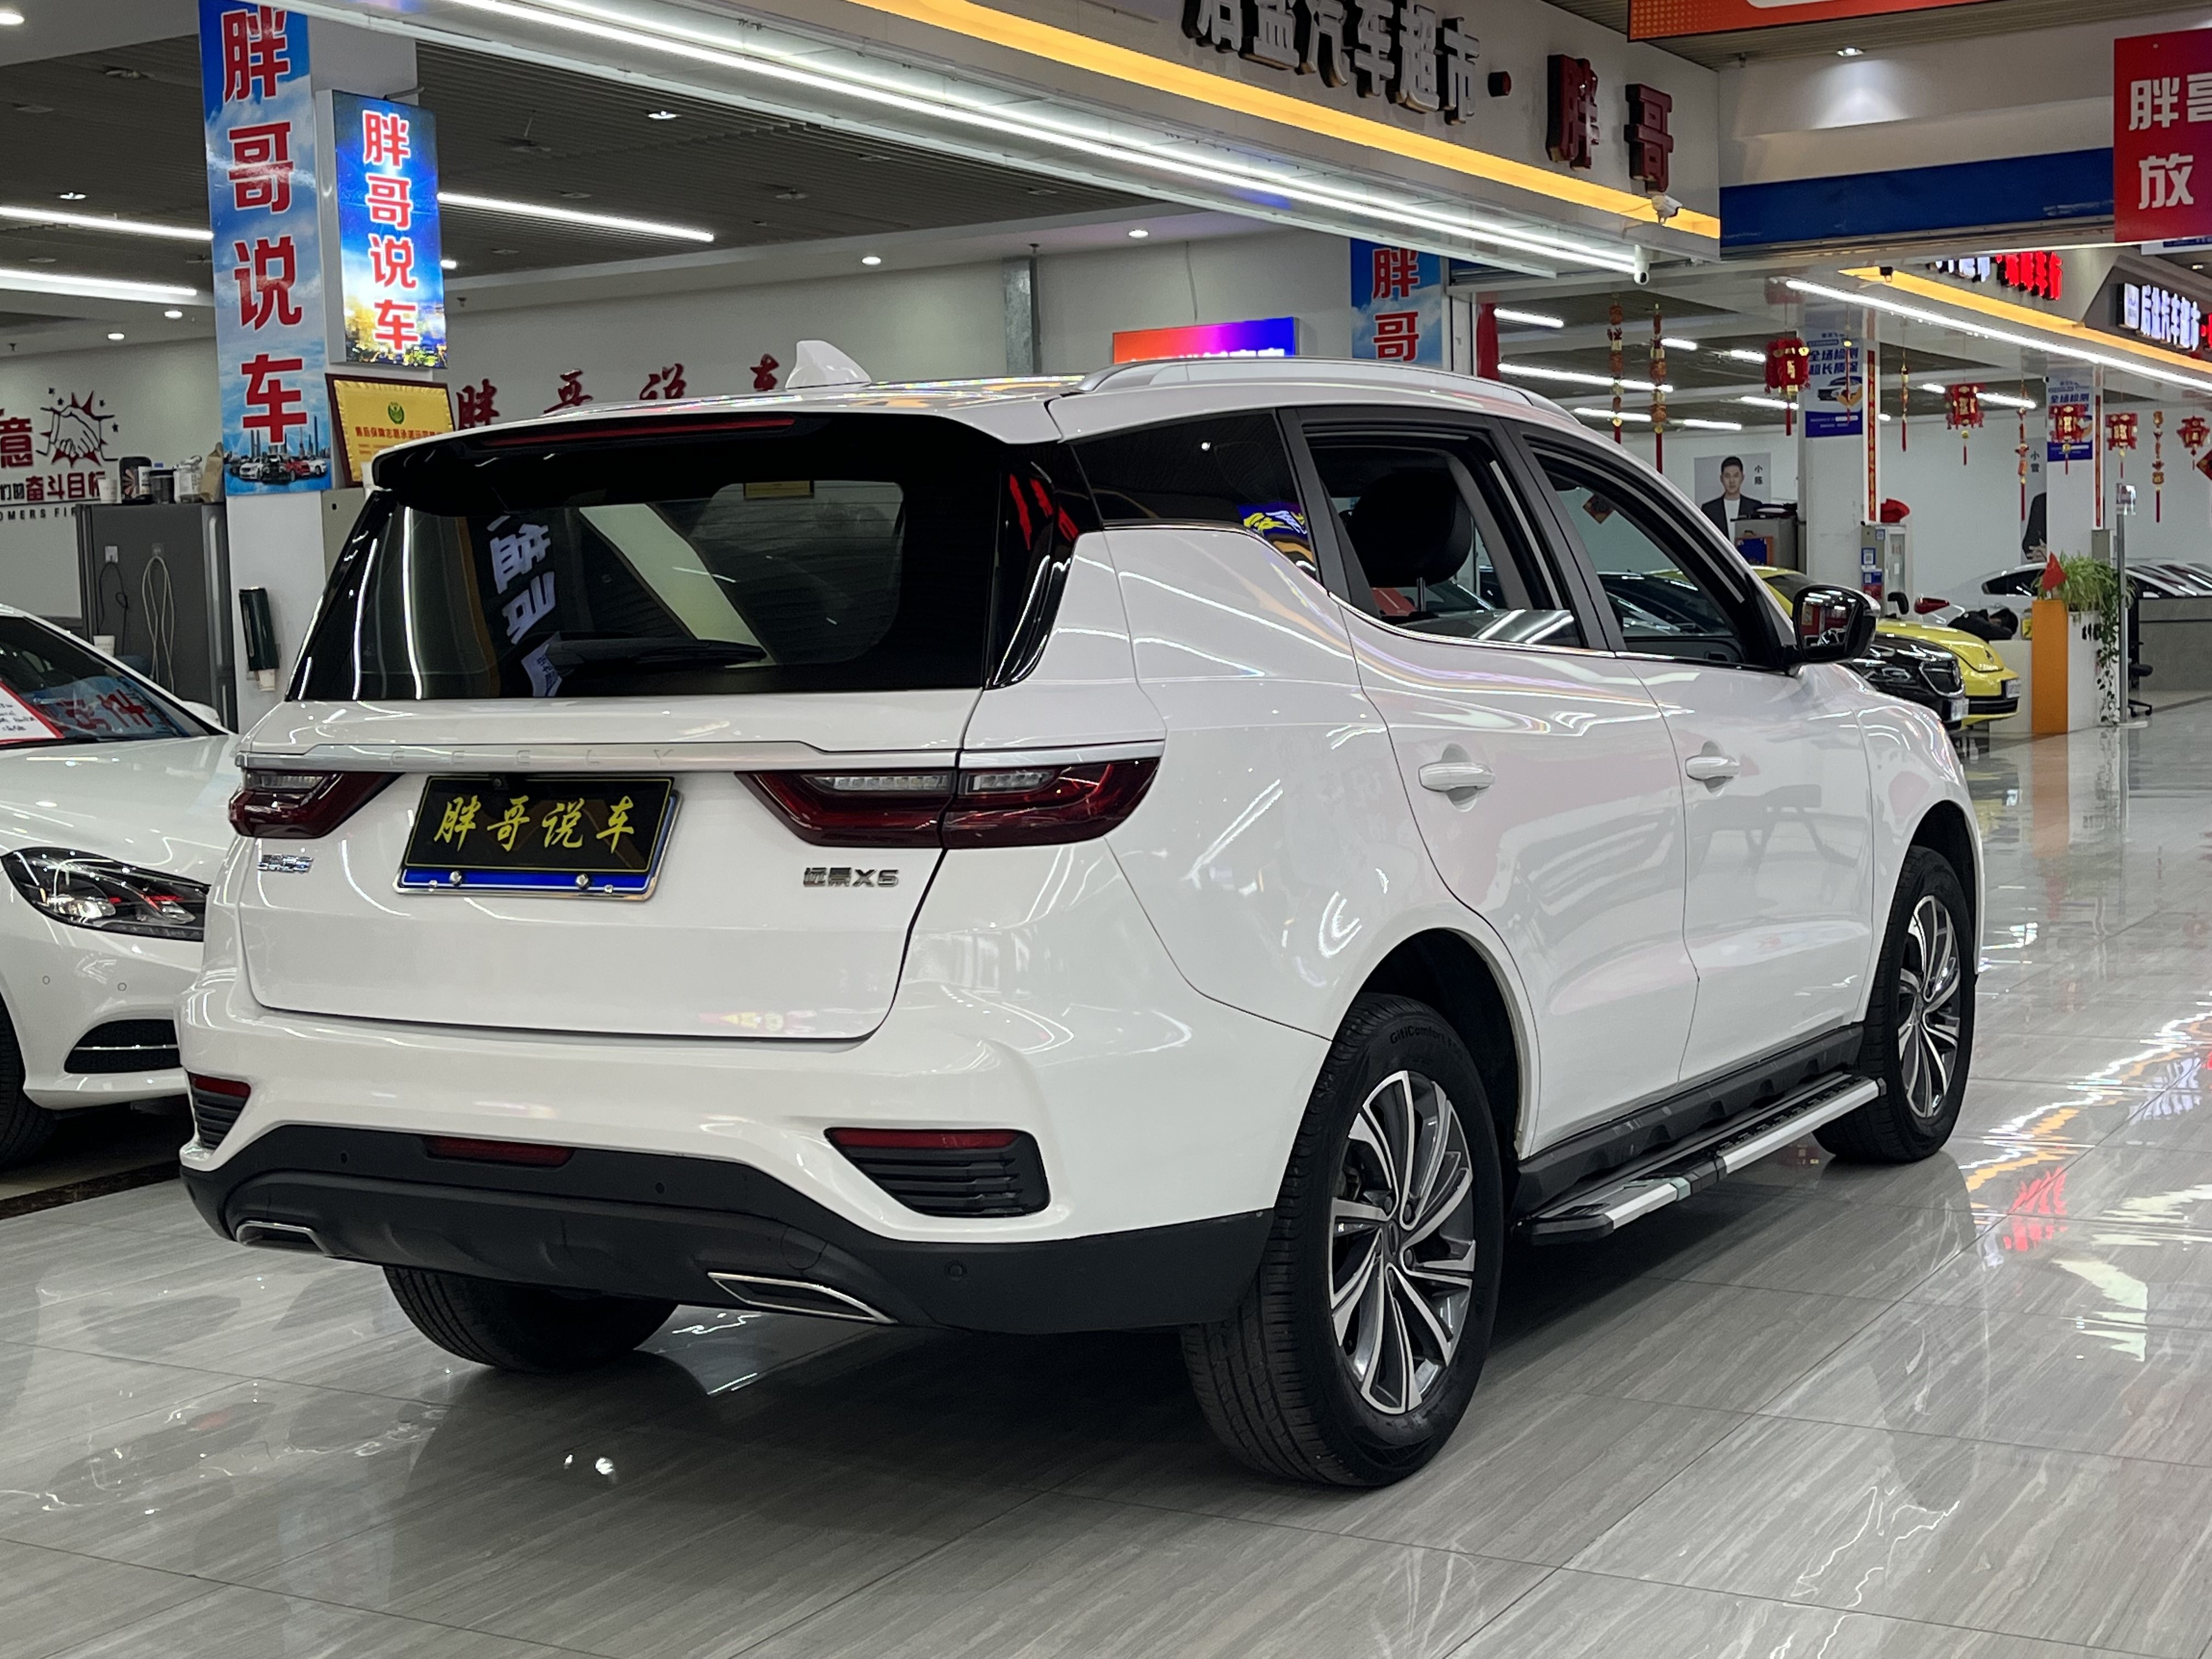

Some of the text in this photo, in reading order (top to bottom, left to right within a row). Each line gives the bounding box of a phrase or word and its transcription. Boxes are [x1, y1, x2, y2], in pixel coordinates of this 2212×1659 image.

[223, 5, 308, 443] 胖哥说车
[363, 111, 421, 352] 胖哥说车
[2138, 153, 2194, 210] 放
[1373, 249, 1419, 362] 胖哥
[434, 795, 635, 854] 胖哥说车
